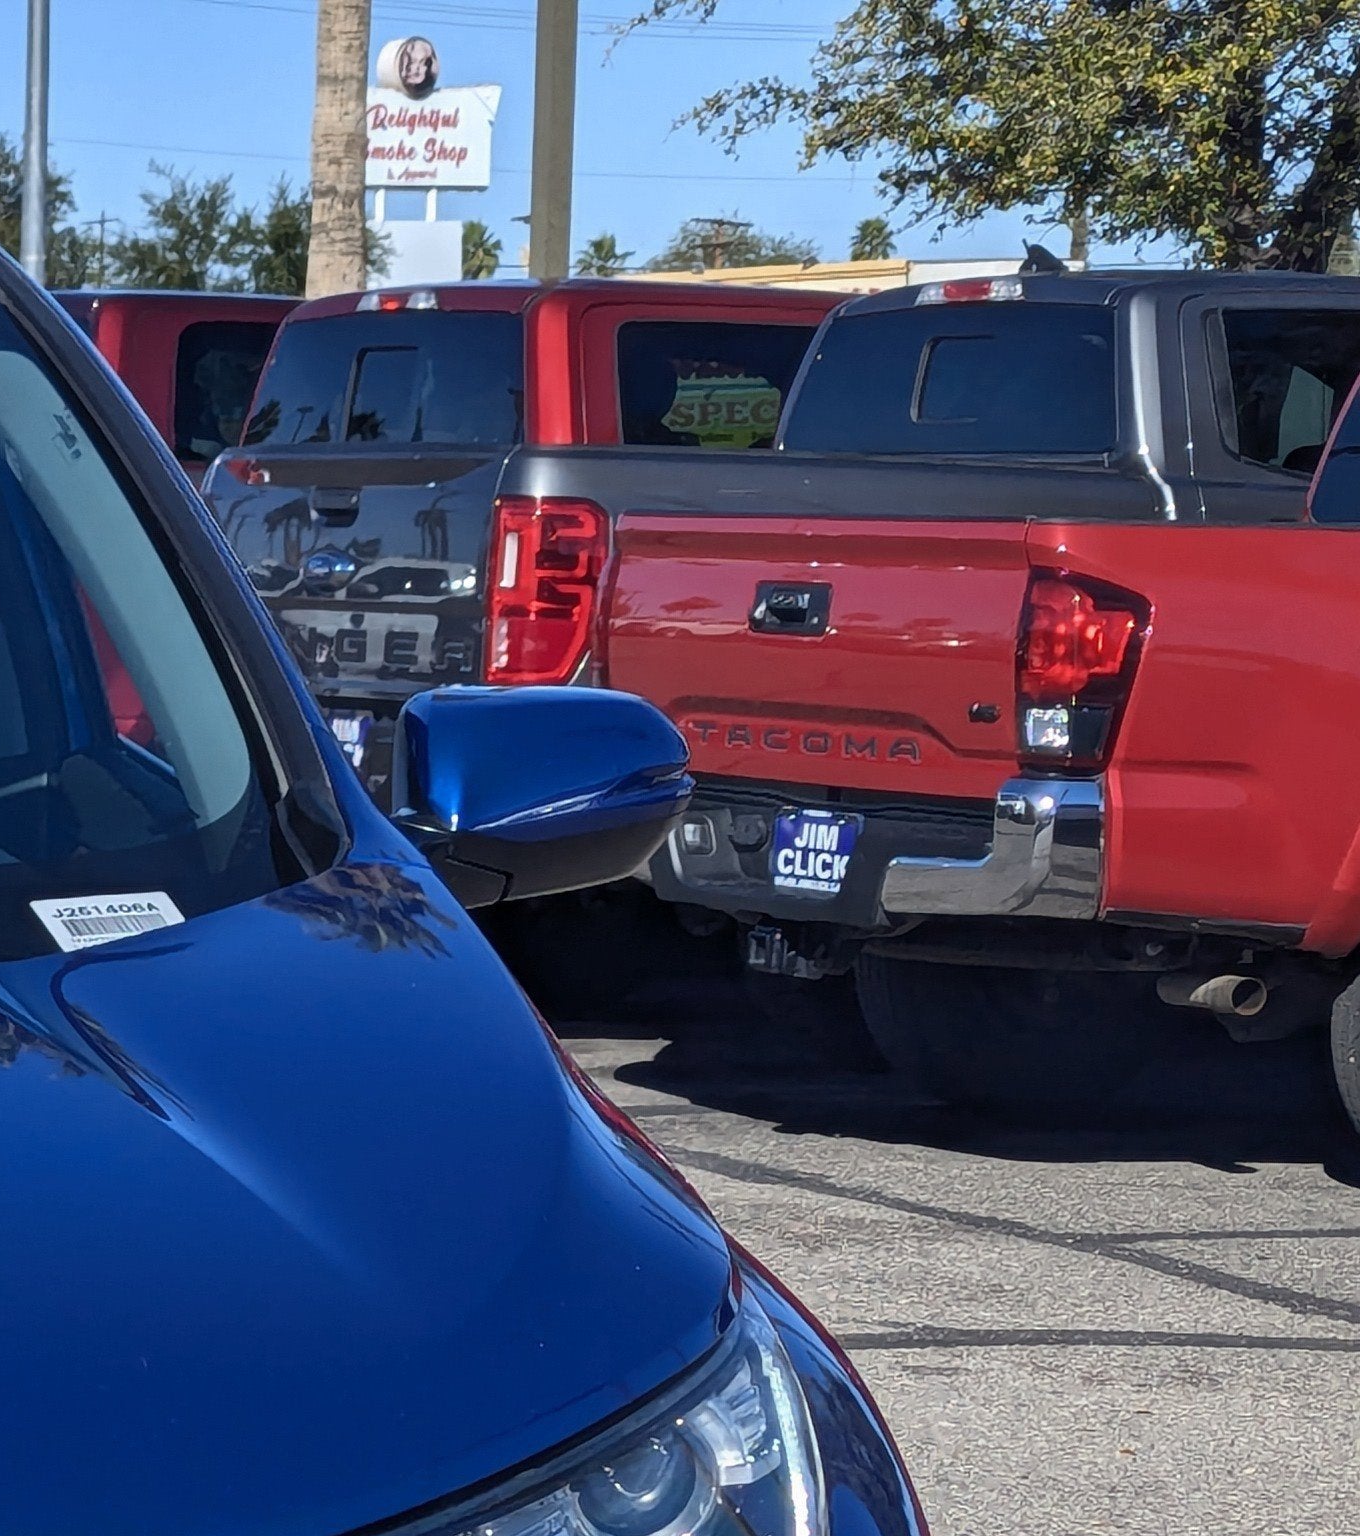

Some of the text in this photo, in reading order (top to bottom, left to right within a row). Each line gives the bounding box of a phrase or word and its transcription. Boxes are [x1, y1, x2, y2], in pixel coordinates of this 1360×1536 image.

[366, 103, 460, 136] Delightful
[365, 137, 469, 169] moke Shop
[687, 719, 923, 766] TACOMA
[793, 822, 841, 852] JIM
[776, 847, 851, 881] CLICK
